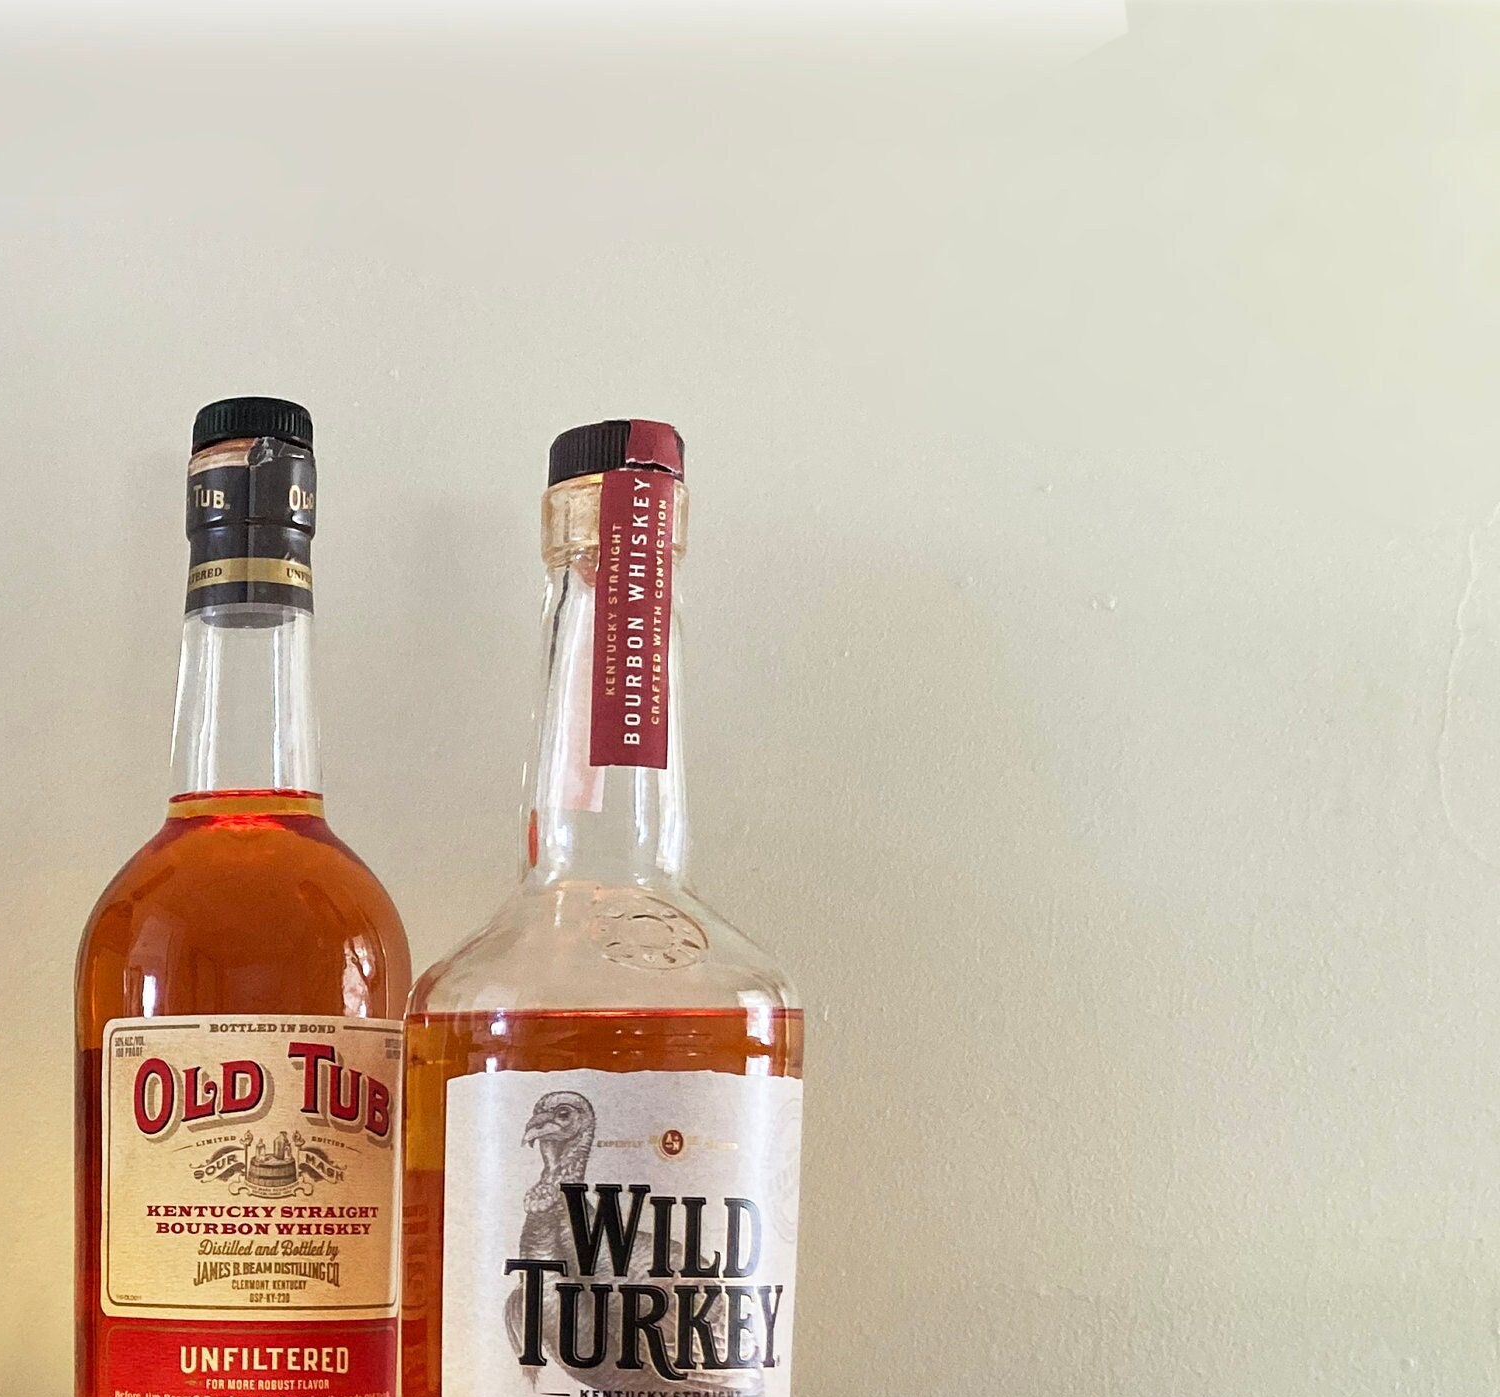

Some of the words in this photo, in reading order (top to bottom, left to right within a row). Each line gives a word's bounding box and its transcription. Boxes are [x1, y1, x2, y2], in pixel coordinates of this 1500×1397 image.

[628, 477, 651, 602] WHISKEY
[654, 500, 668, 599] CONVICTION
[608, 523, 623, 605] STRAIGHT
[653, 606, 663, 647] WITH
[604, 612, 618, 697] KENTUCKY
[623, 616, 646, 745] BOURBON
[651, 652, 662, 725] CRAFTED
[209, 1024, 278, 1033] BOTTLED
[280, 1024, 296, 1033] IN
[299, 1024, 336, 1034] BOND
[133, 1057, 270, 1137] OLD
[288, 1042, 393, 1138] TUB
[196, 1135, 237, 1147] LIMITED
[193, 1154, 238, 1181] SOUR
[305, 1154, 345, 1182] MASH
[147, 1205, 276, 1218] KENTUCKY
[280, 1206, 379, 1218] STRAIGHT
[155, 1223, 272, 1235] BOURBON
[275, 1224, 372, 1235] WHISKEY
[560, 1183, 762, 1279] WILD
[198, 1239, 253, 1257] Distilled
[255, 1240, 279, 1256] and
[281, 1239, 323, 1257] Bottled
[325, 1241, 340, 1260] by
[194, 1262, 231, 1286] JAMES
[233, 1262, 242, 1276] B.
[243, 1262, 273, 1275] BEAM
[274, 1262, 326, 1281] DISTILLING
[272, 1280, 307, 1290] KENTUCKY
[504, 1259, 784, 1381] TURKEY
[179, 1346, 349, 1375] UNFILTERED
[206, 1379, 225, 1390] FOR
[227, 1380, 255, 1390] MORE
[257, 1380, 295, 1390] ROBUST
[297, 1379, 330, 1390] FLAVOR
